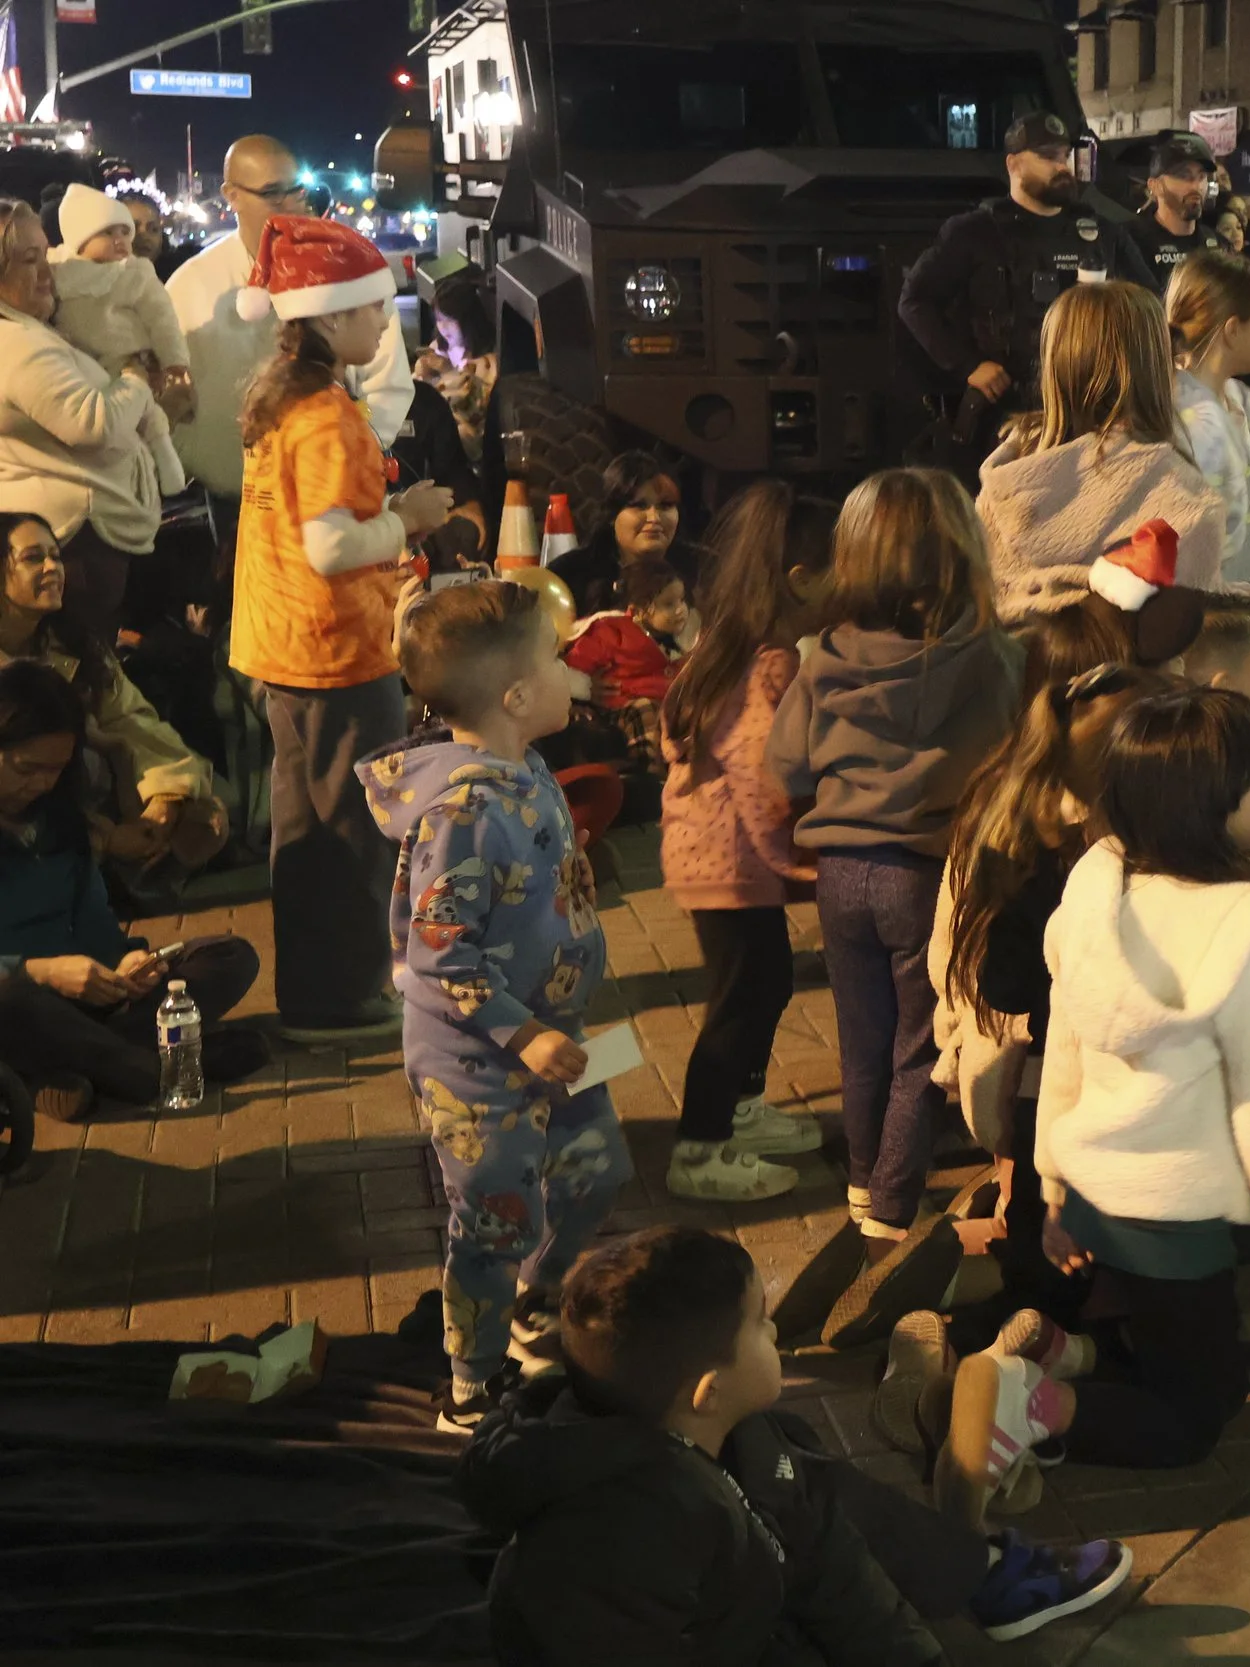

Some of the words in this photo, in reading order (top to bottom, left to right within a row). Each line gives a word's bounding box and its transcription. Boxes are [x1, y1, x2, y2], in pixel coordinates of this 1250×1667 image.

[160, 72, 213, 87] Redlands
[218, 75, 244, 89] Blvd
[546, 204, 578, 262] POLICE
